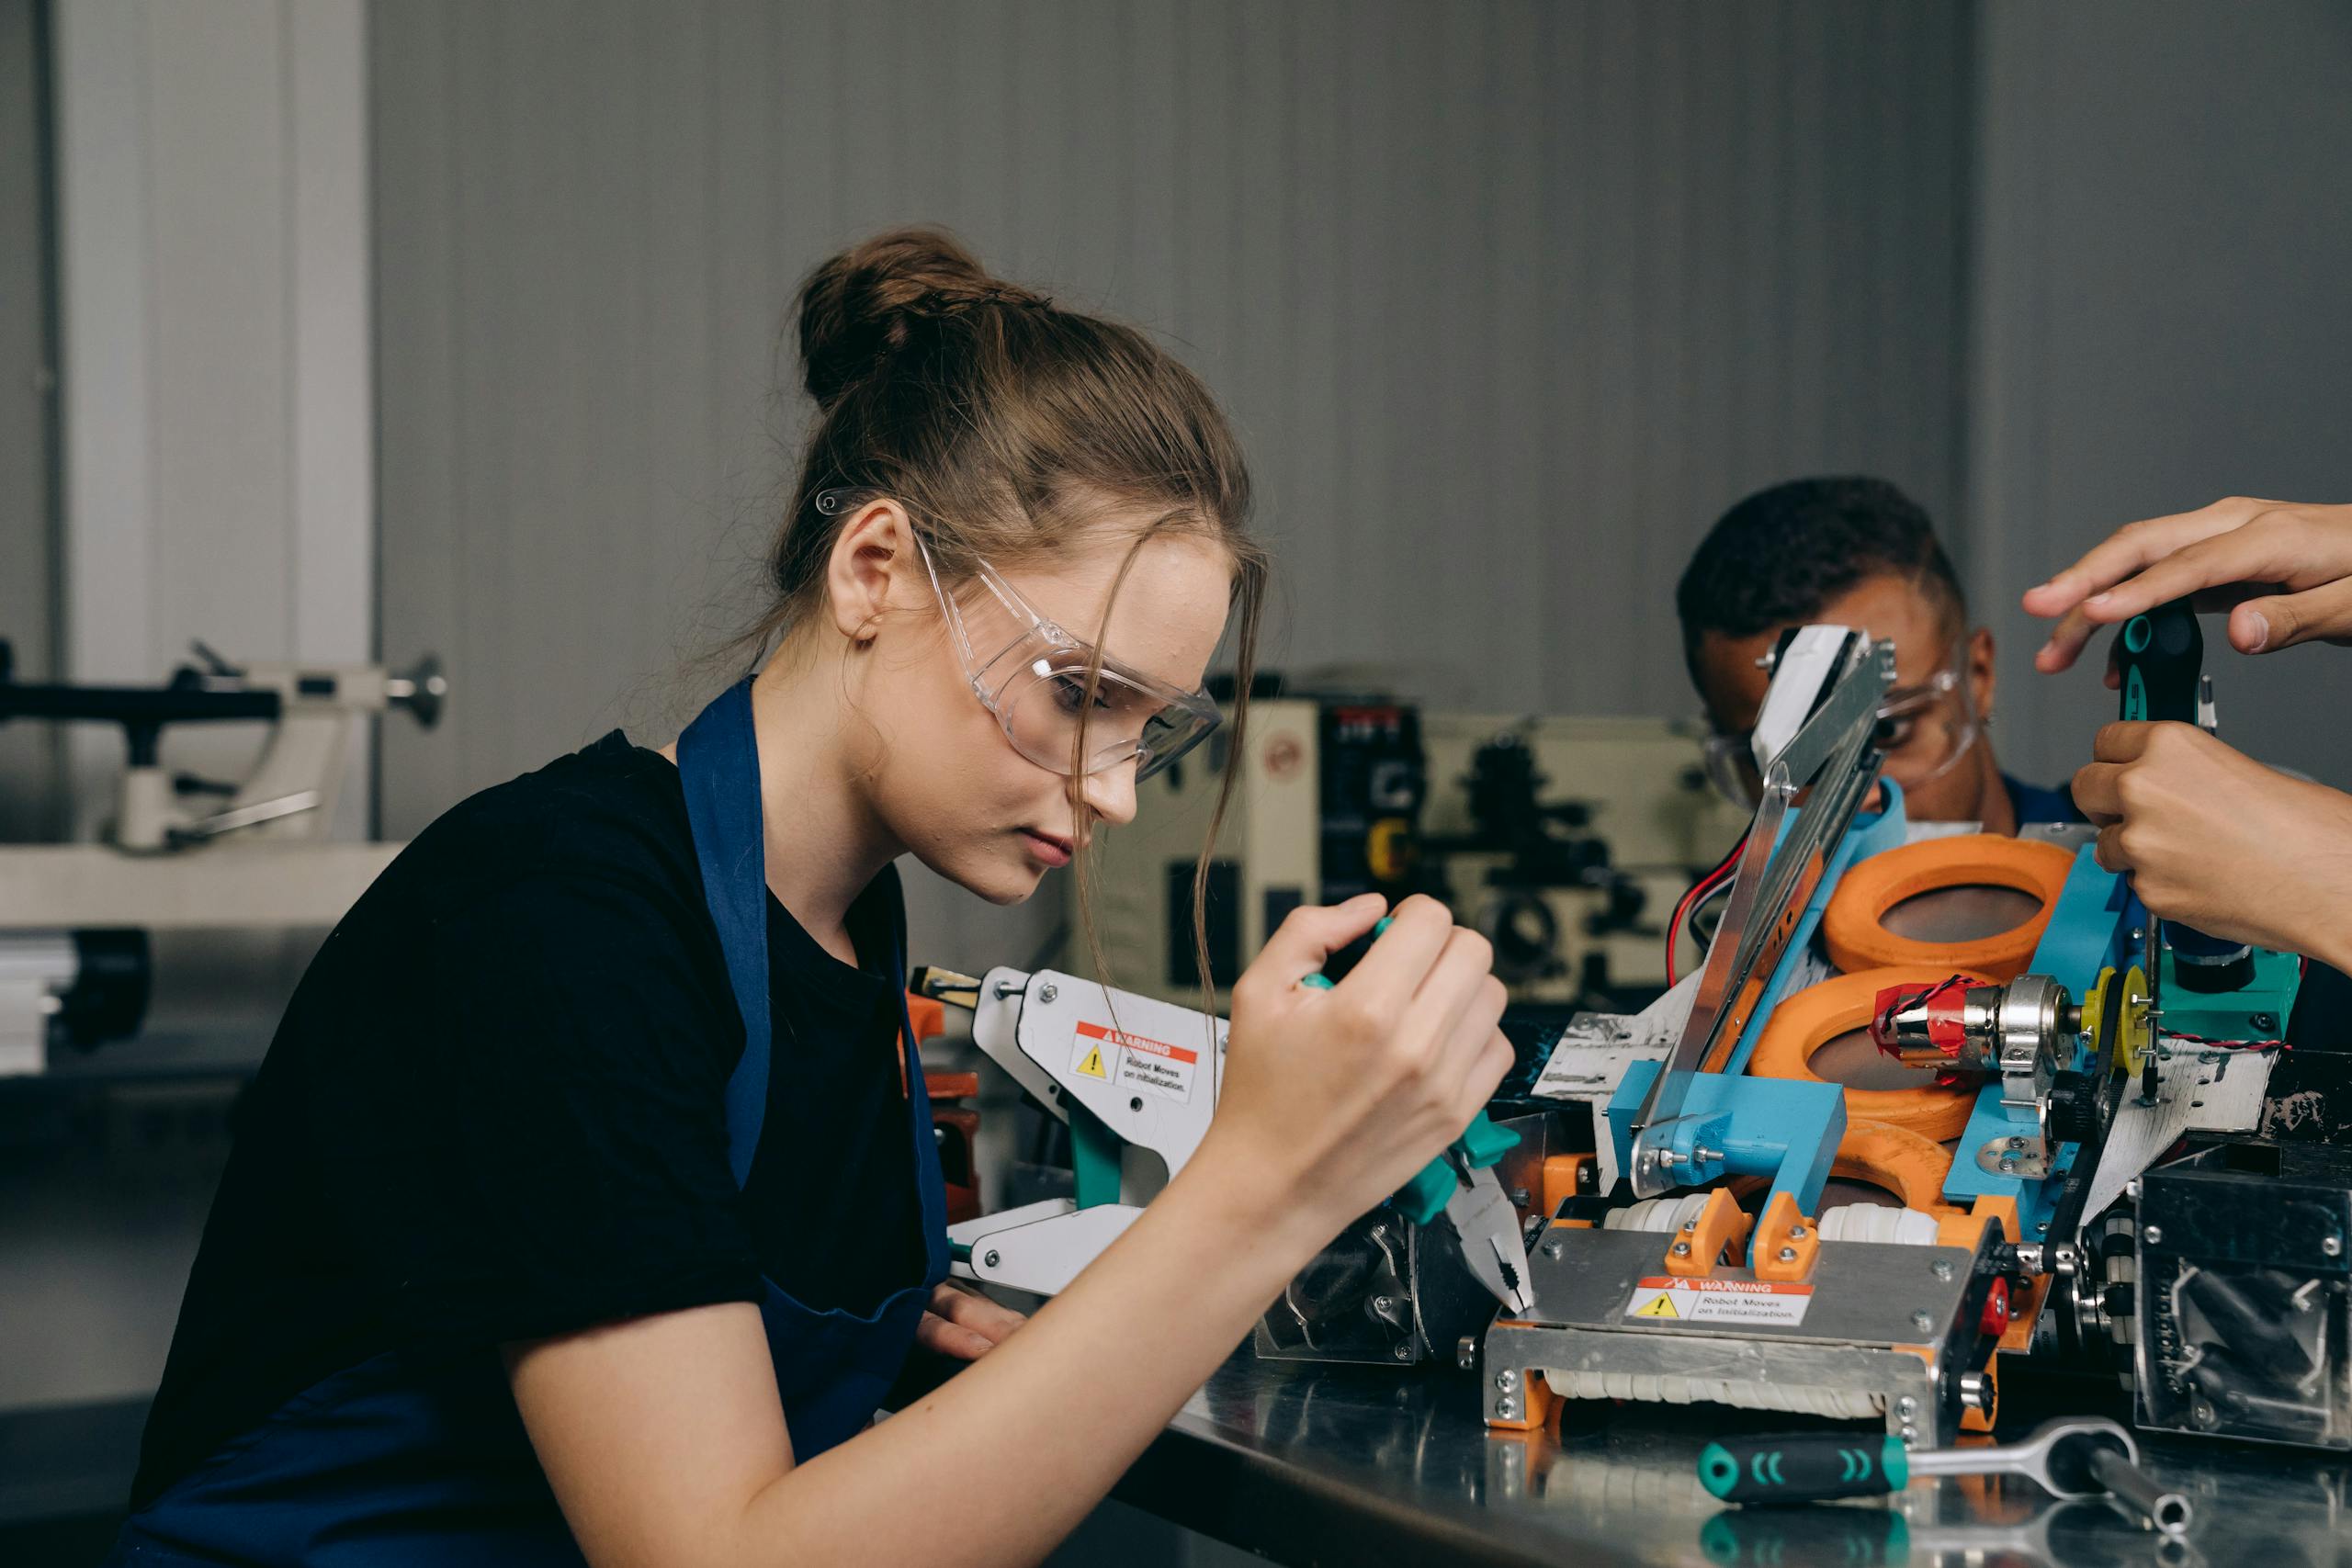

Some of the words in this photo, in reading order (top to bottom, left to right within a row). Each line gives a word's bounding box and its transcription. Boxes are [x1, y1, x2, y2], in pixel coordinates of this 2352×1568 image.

[1115, 1032, 1170, 1056] WARNING
[1126, 1057, 1151, 1070] Robot
[1154, 1065, 1179, 1077] Moves
[1700, 1280, 1771, 1292] WARNING
[1702, 1296, 1738, 1305] Robot
[1742, 1298, 1781, 1306] Moves
